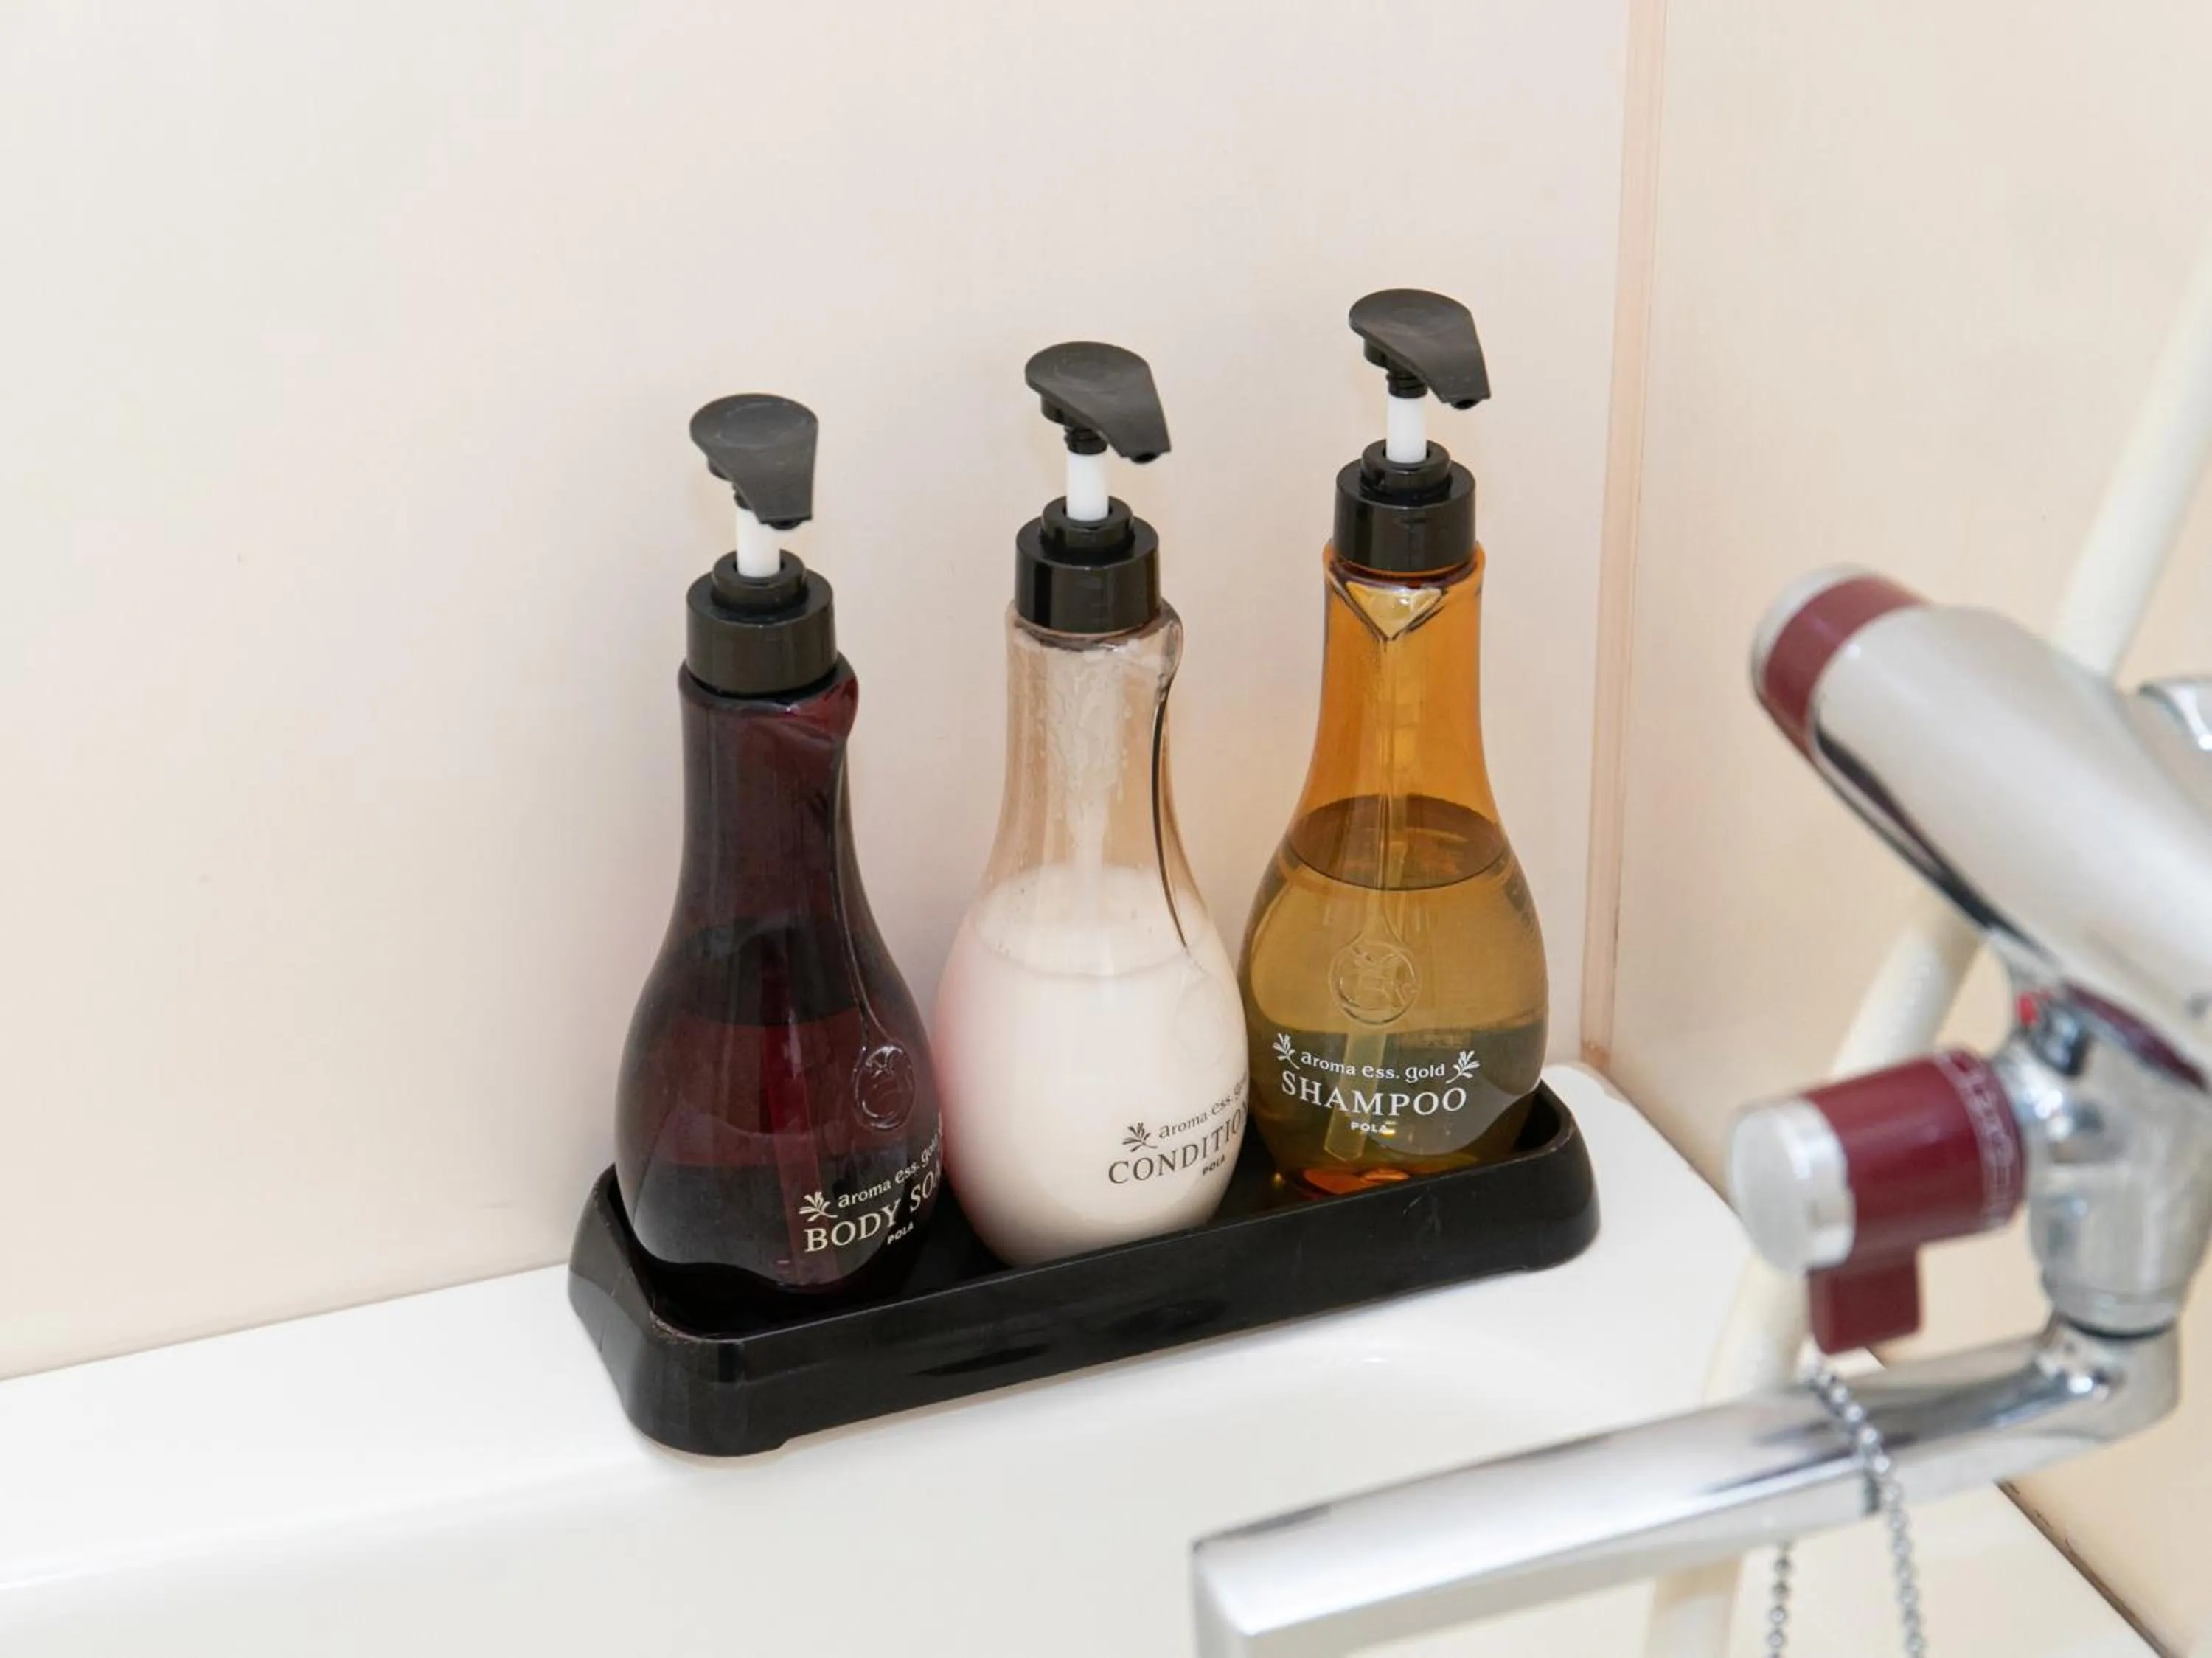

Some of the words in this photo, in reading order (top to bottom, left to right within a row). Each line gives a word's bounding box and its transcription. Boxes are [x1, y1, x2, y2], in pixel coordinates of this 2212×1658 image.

[1301, 1050, 1355, 1076] aroma
[1362, 1065, 1399, 1080] ess.
[1405, 1064, 1444, 1083] gold
[1281, 1071, 1467, 1116] SHAMPOO
[1158, 1111, 1208, 1139] aroma
[1350, 1121, 1388, 1134] POLA
[1203, 1154, 1225, 1176] POLA
[838, 1179, 891, 1208] aroma
[804, 1198, 901, 1253] BODY
[887, 1221, 914, 1245] POLA
